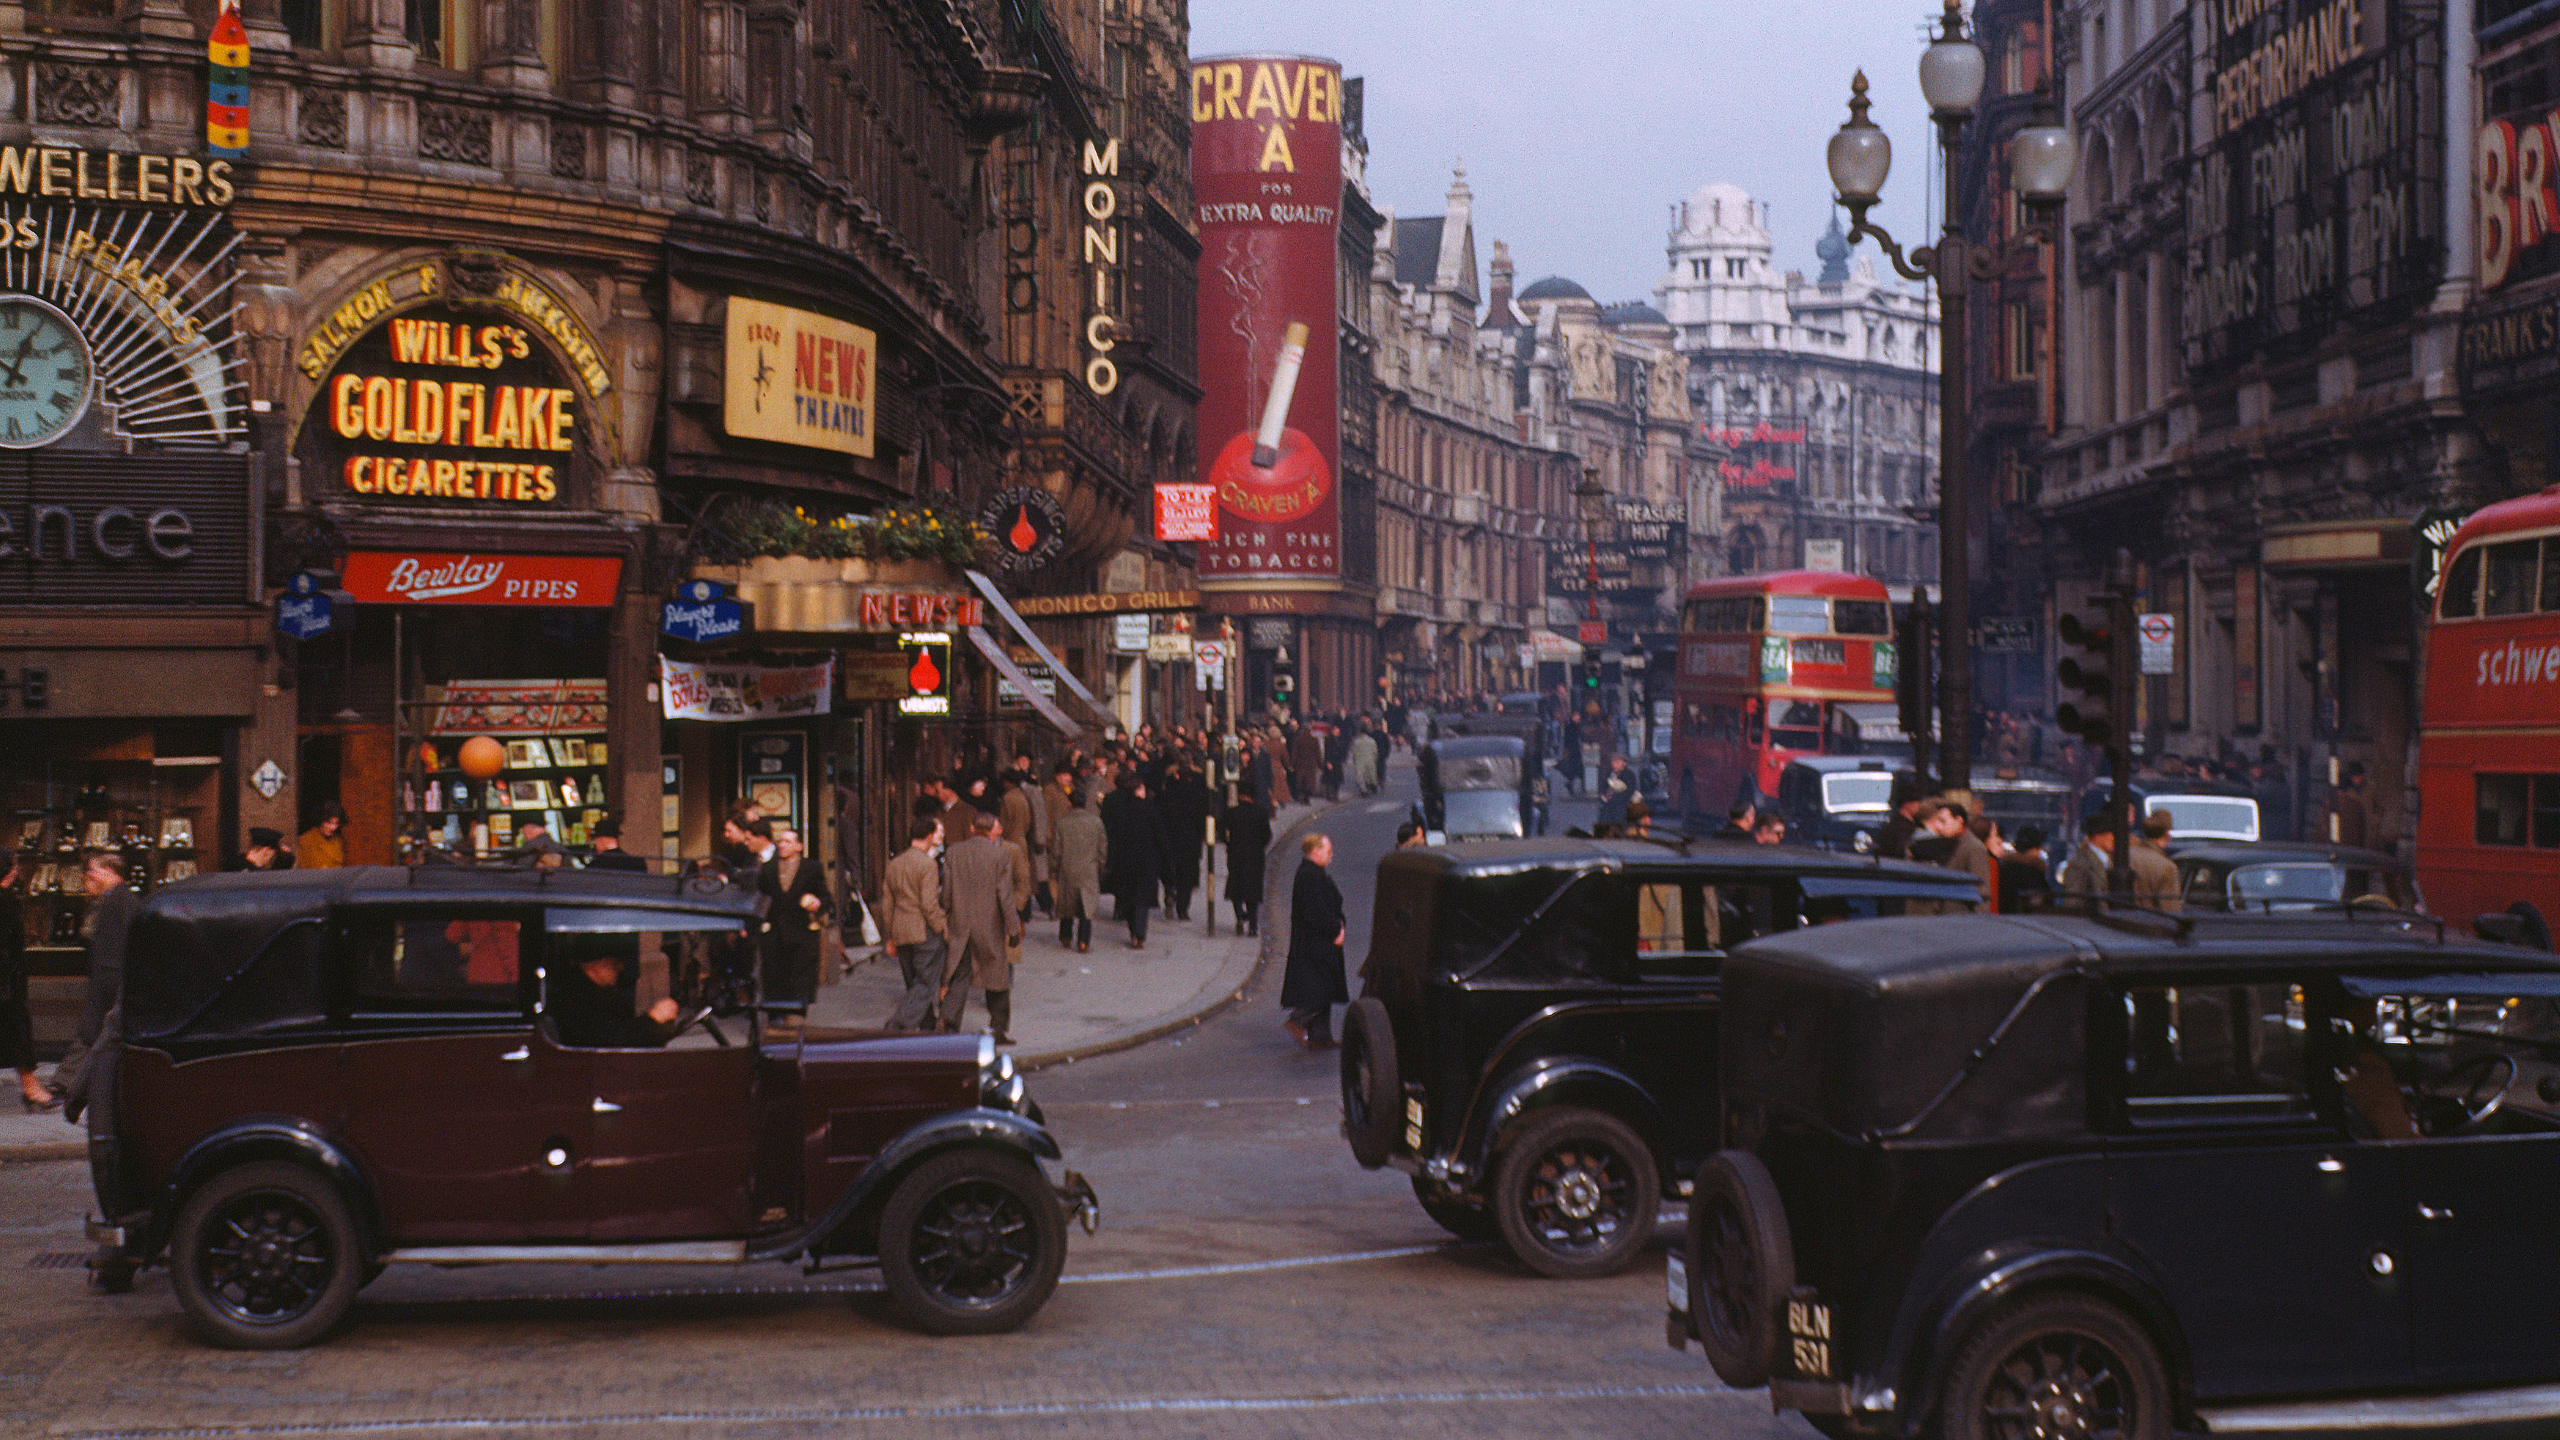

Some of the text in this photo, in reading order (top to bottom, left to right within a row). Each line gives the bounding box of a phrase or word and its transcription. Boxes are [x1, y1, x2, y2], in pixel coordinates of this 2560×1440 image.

[2217, 0, 2363, 138] PERFORMANCE
[1192, 62, 1342, 124] CRAVEN
[1261, 182, 1293, 196] FOR
[1200, 203, 1334, 225] EXTRA QUALITY
[1083, 137, 1118, 395] MONICO
[69, 229, 202, 344] PEARLS
[300, 279, 394, 379] SALMON
[748, 322, 781, 346] EROS
[795, 330, 866, 403] NEWS
[795, 394, 865, 438] THEATRE
[345, 456, 557, 502] CIGARETTES
[1220, 480, 1300, 514] CRAVEN
[1615, 502, 1687, 523] TREASURE
[1286, 532, 1332, 548] FINE
[1631, 523, 1671, 541] HUNT
[1208, 552, 1333, 568] TOBACCO
[386, 555, 579, 600] Bewlay PIPES
[1560, 577, 1630, 592] CLEENTS
[860, 591, 951, 624] NEWS
[1017, 590, 1195, 617] MONICO GRILL
[1249, 595, 1296, 610] BANK
[2476, 637, 2560, 687] schwe
[1788, 1300, 1831, 1341] BLN
